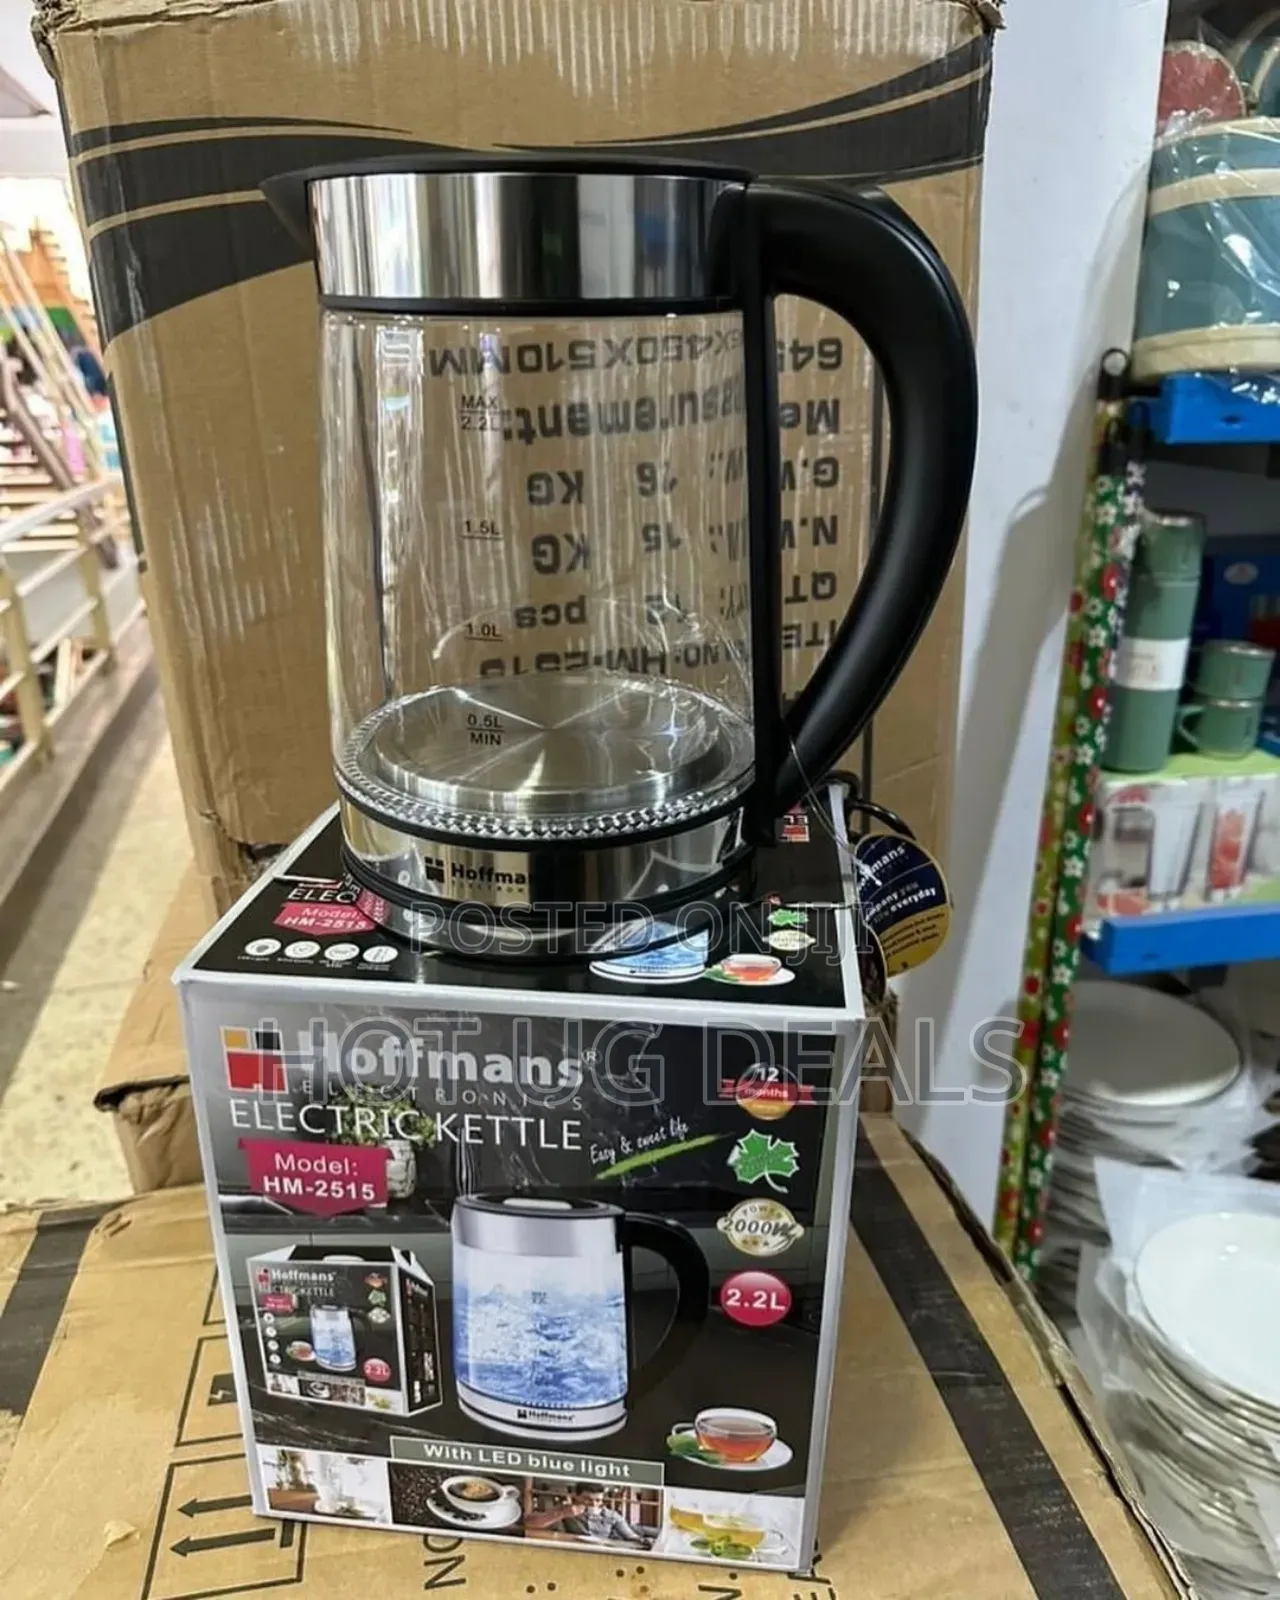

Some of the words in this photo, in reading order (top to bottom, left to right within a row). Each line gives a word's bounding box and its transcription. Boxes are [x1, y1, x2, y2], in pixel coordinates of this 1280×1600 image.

[461, 396, 498, 409] MAX
[461, 416, 500, 430] 2.2L
[527, 470, 584, 505] KG
[465, 520, 500, 535] 1.5L
[642, 523, 681, 553] 15
[532, 533, 590, 575] KG
[515, 594, 587, 629] pcs
[467, 622, 500, 637] 1.0L
[467, 713, 503, 728] 0.5L
[470, 732, 502, 746] MIN
[890, 887, 937, 913] everyday
[284, 916, 368, 930] HM-2515
[756, 1067, 779, 1082] 12
[230, 1100, 421, 1140] ELECTRIC
[436, 1112, 583, 1150] KETTLE
[590, 1143, 616, 1165] Easy
[620, 1136, 633, 1154] &
[669, 1115, 689, 1141] life
[274, 1152, 359, 1177] Model:
[263, 1175, 376, 1201] HM-2515
[725, 1288, 786, 1312] 2.2L
[423, 1443, 472, 1462] With
[479, 1450, 521, 1466] LED
[529, 1454, 574, 1472] blue
[580, 1462, 630, 1479] light
